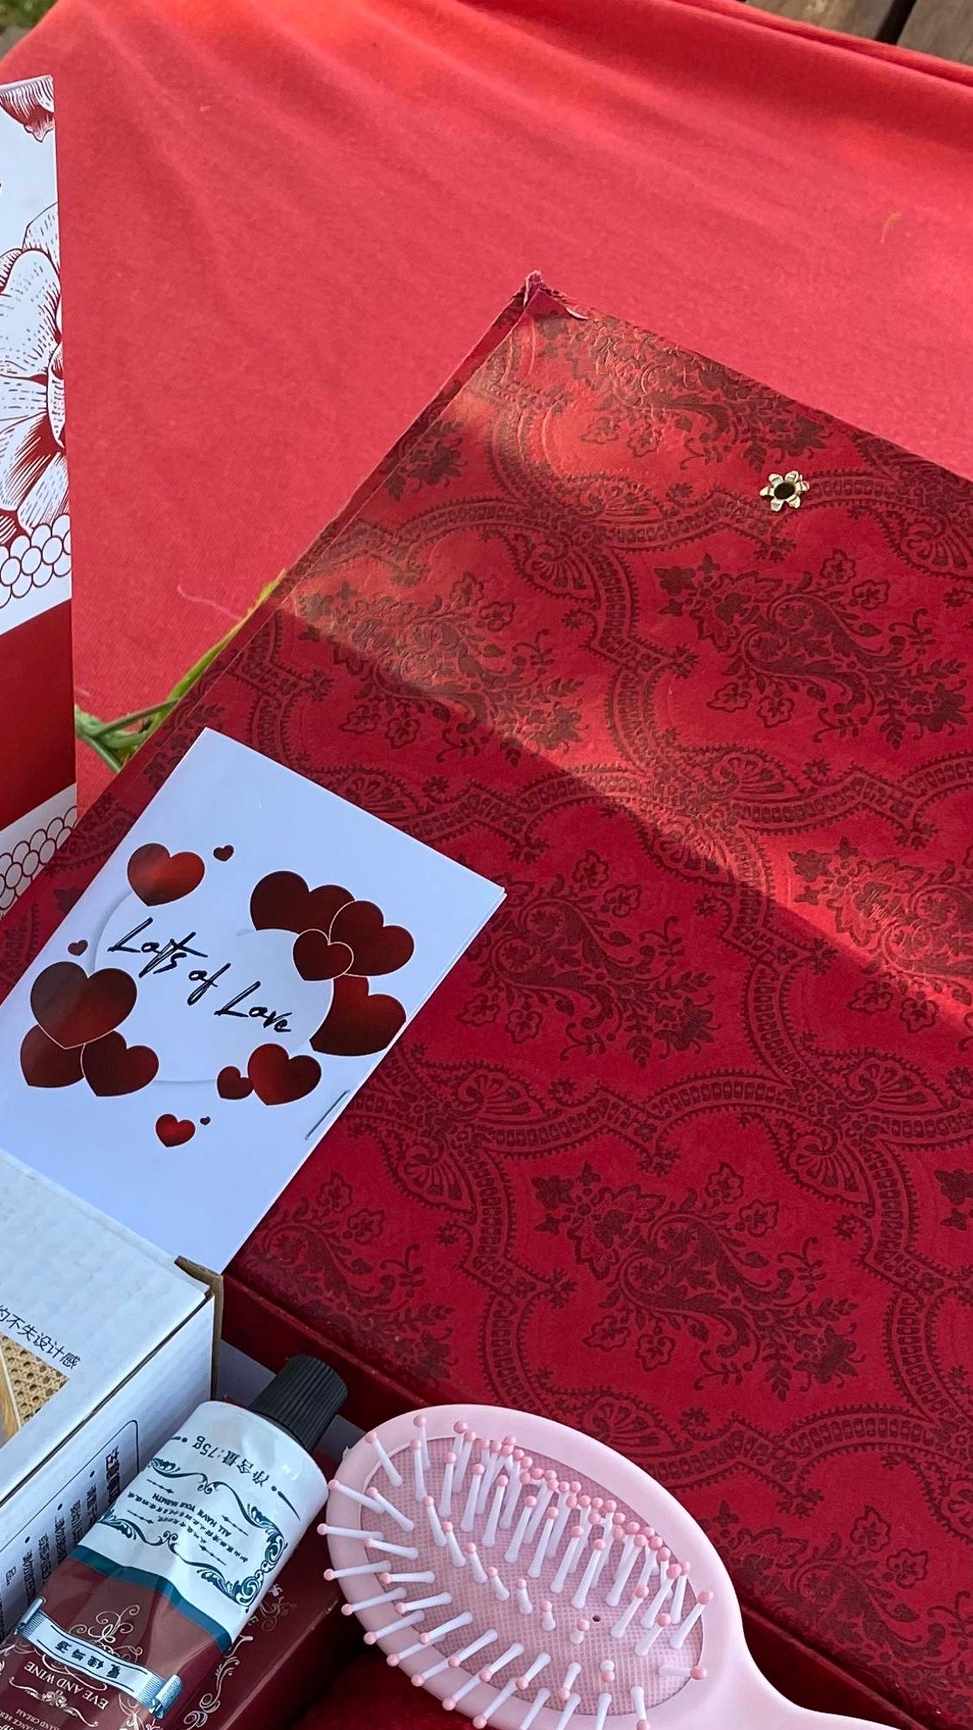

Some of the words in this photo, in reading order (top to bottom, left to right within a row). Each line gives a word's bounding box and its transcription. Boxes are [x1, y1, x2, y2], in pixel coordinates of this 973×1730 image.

[187, 963, 231, 1006] of
[214, 981, 292, 1033] Love
[197, 1509, 218, 1527] HAVE
[218, 1525, 232, 1538] ALL
[24, 1661, 58, 1684] WINE
[56, 1677, 83, 1695] AND
[82, 1689, 109, 1710] EVE
